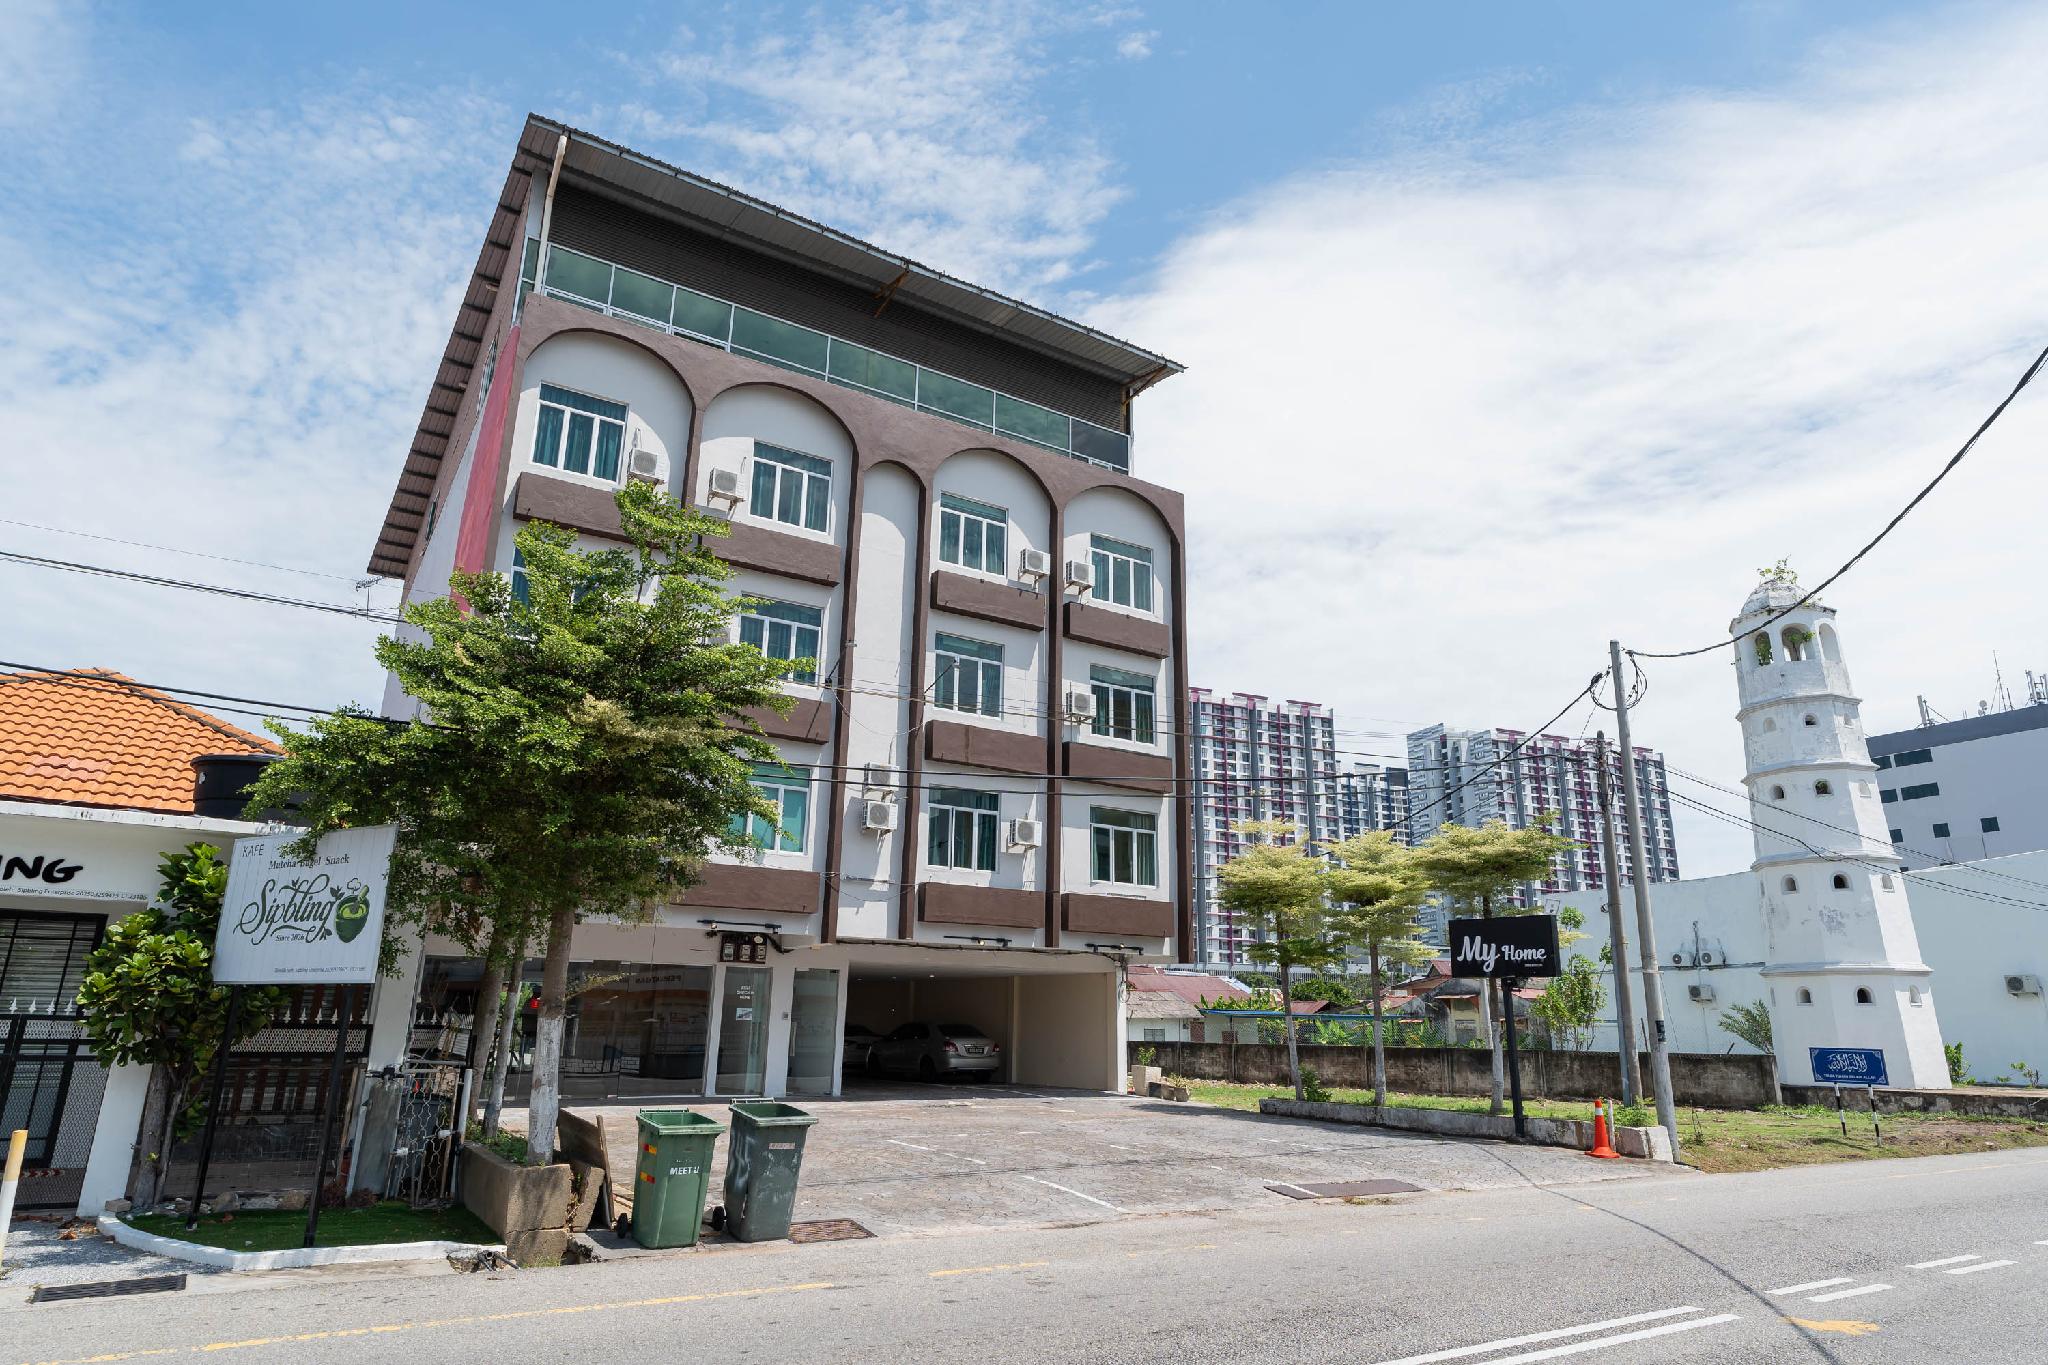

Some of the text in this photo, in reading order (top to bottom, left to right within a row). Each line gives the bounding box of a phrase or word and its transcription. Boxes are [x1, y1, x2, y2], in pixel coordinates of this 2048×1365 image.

[242, 844, 264, 857] KAFE
[269, 859, 297, 869] Matcha
[325, 854, 350, 865] Snack
[233, 874, 336, 945] Sipbling
[1457, 935, 1547, 973] My Home
[669, 1166, 693, 1176] MEET
